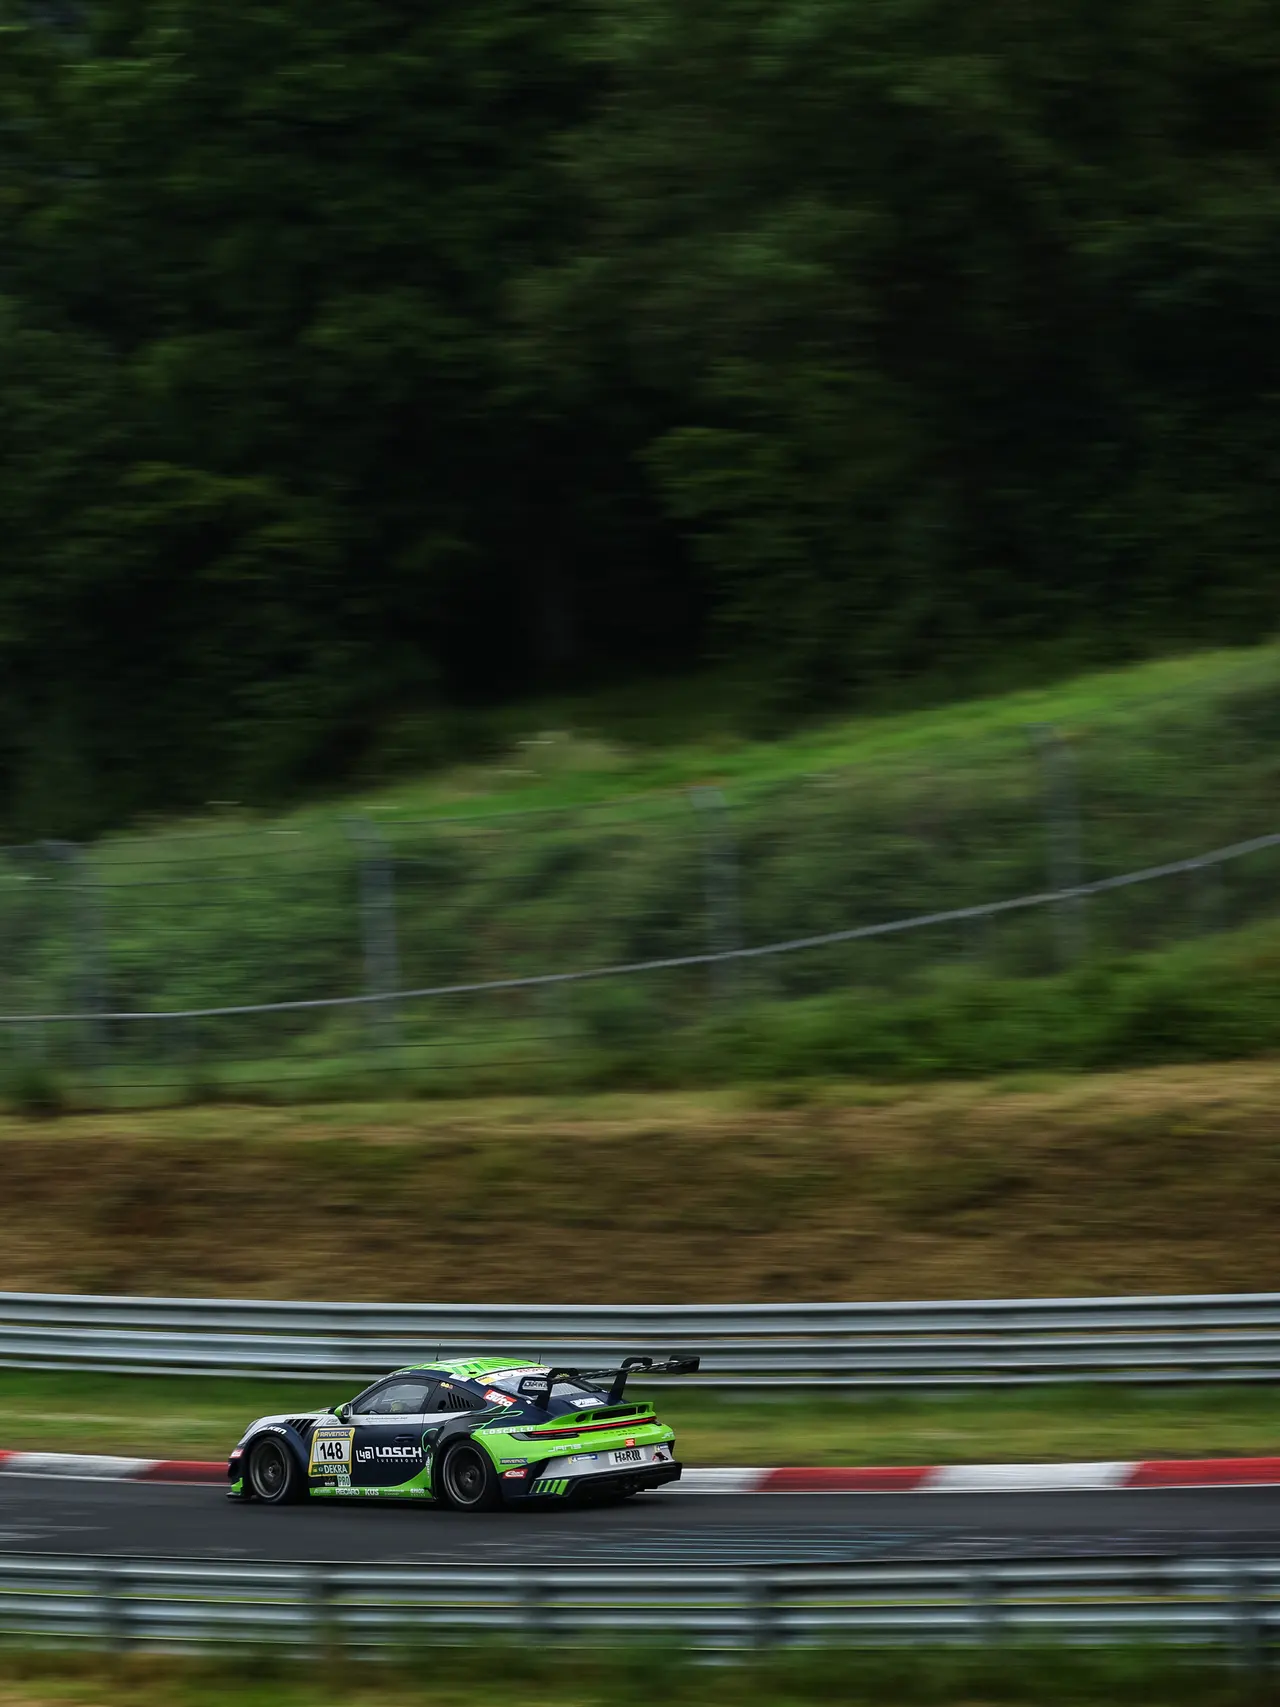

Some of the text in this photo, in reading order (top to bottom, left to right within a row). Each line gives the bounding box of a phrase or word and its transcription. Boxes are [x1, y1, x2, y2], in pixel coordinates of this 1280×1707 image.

[320, 1442, 343, 1460] 148
[376, 1446, 422, 1457] LOSCH
[324, 1464, 348, 1474] DEKRA
[335, 1488, 360, 1496] RECARO
